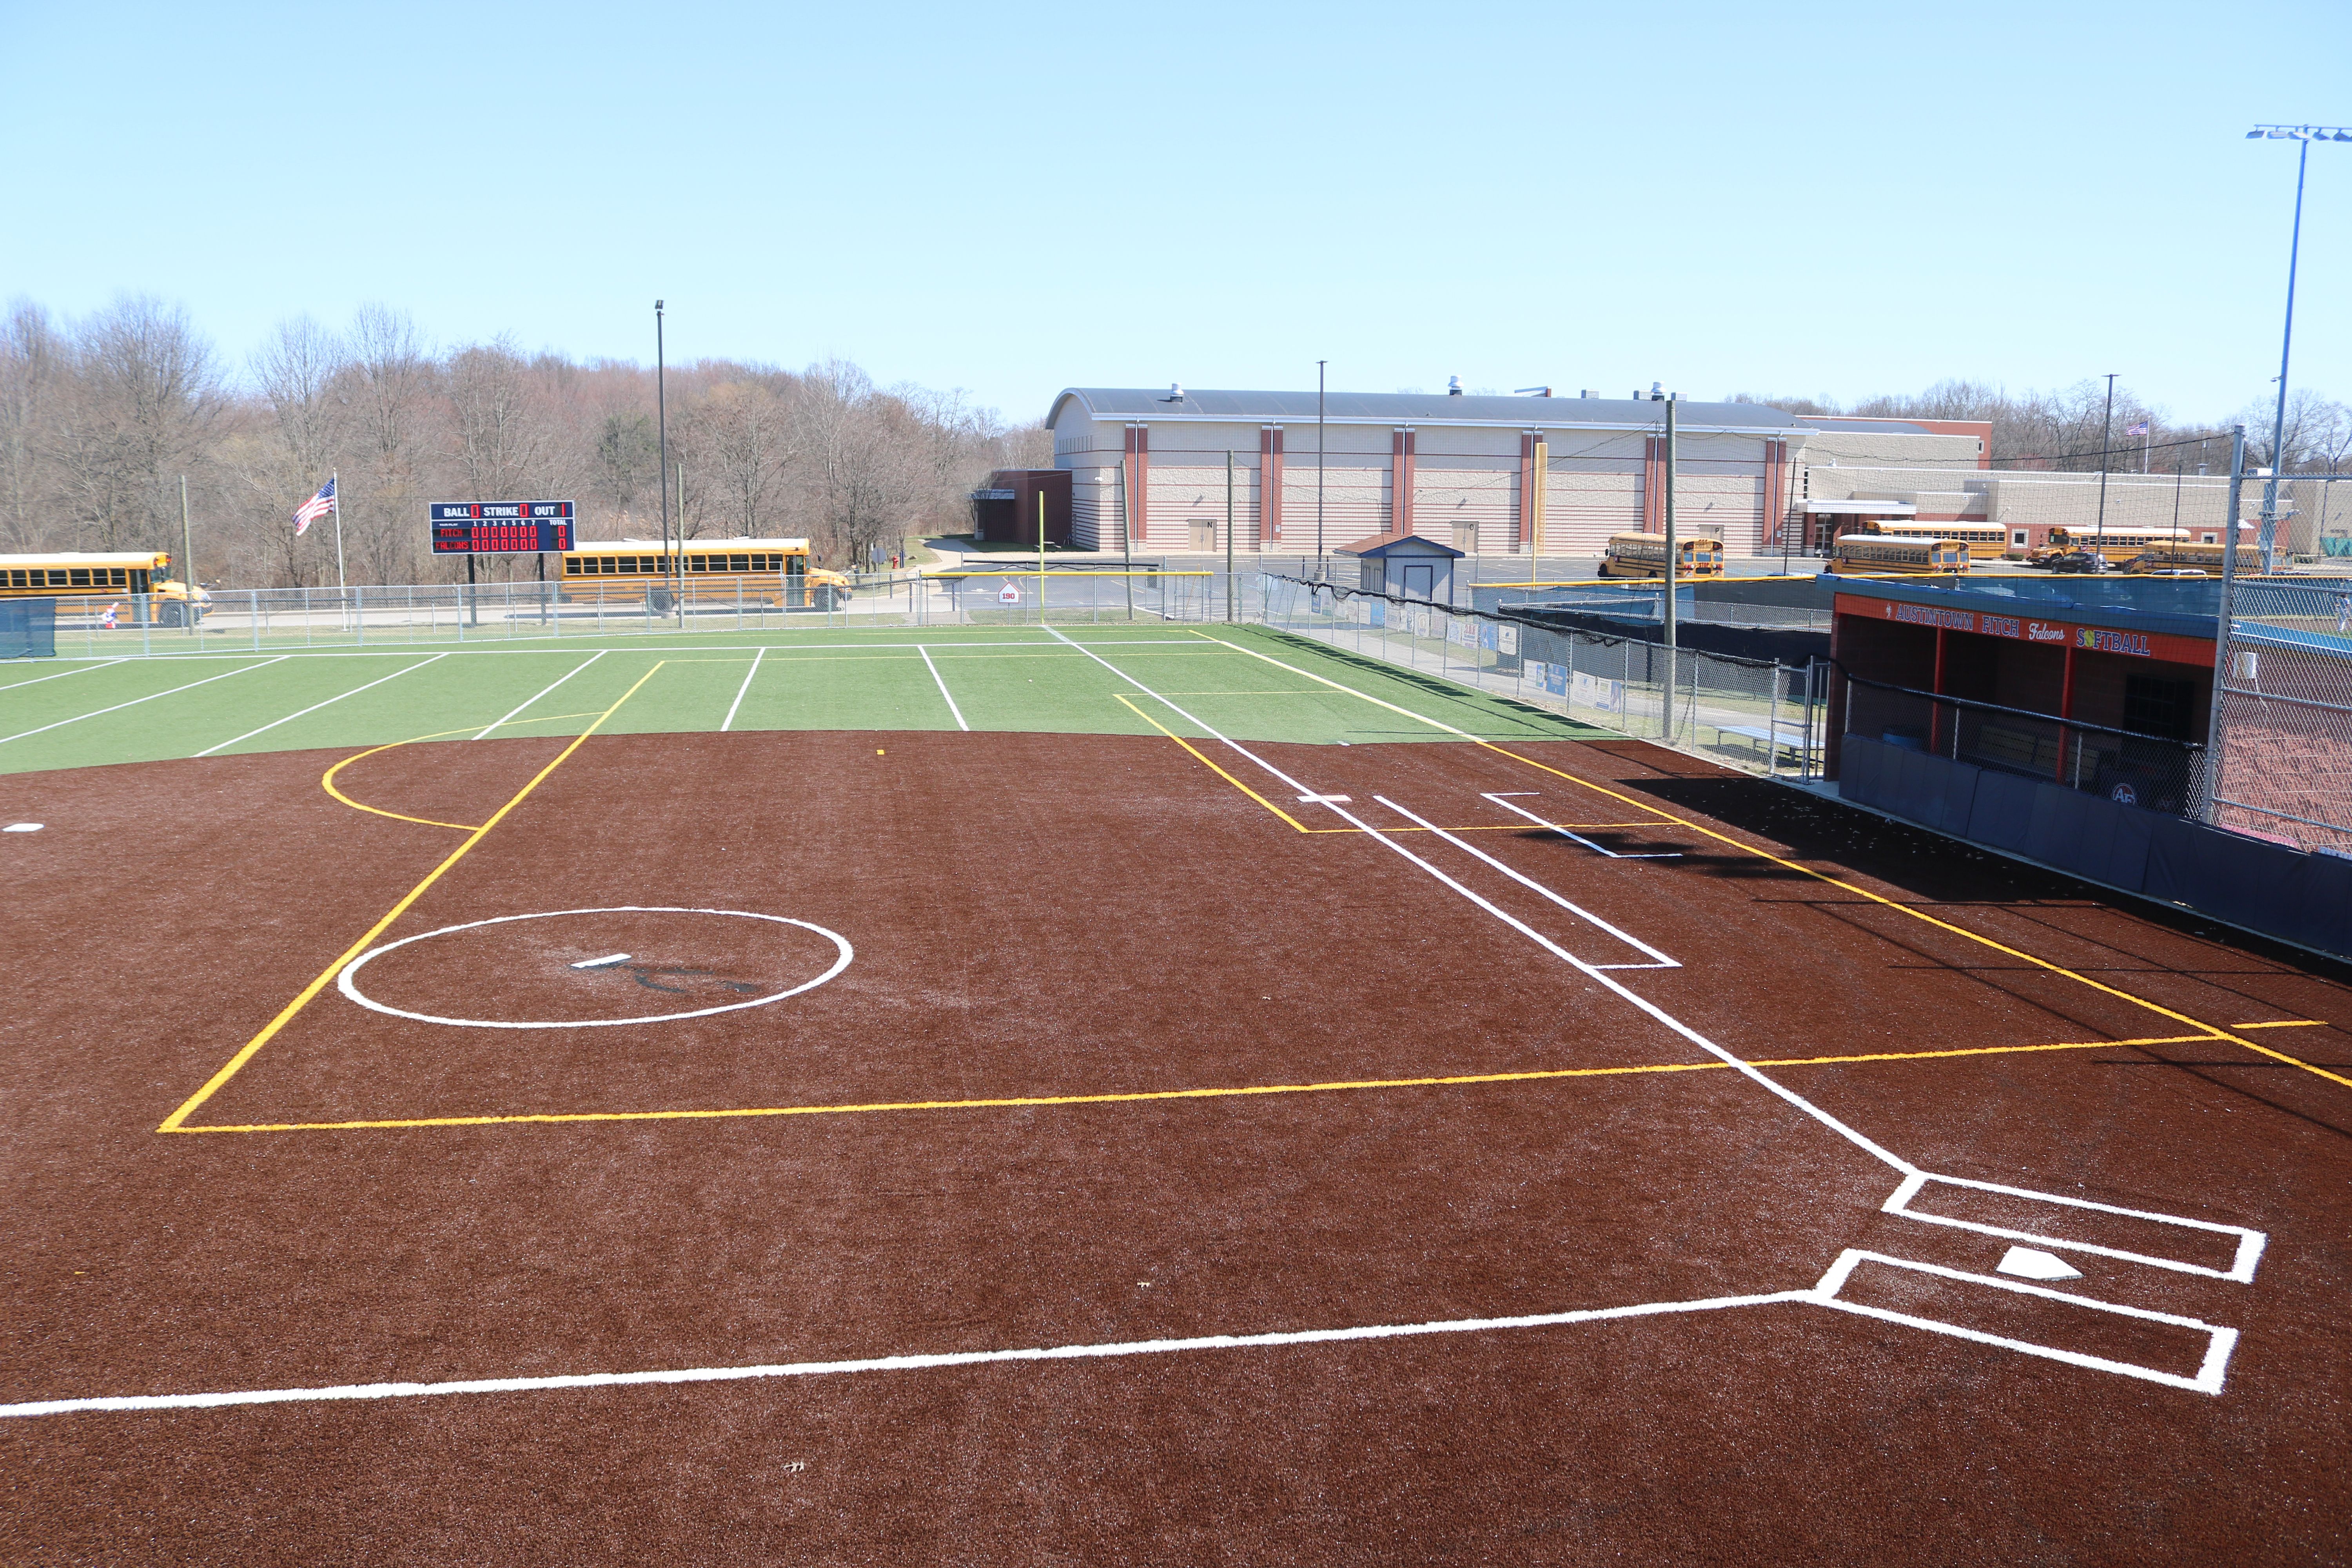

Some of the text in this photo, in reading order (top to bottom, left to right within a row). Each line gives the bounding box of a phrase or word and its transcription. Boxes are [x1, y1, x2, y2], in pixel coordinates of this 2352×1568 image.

[444, 507, 470, 517] BALL
[483, 506, 519, 516] STRIKE
[534, 506, 555, 516] OUT
[436, 541, 469, 550] FALCONS
[1896, 604, 1973, 631] AUSTINTOWN
[1982, 616, 2019, 637] FITCH
[2029, 622, 2065, 640] Falcons
